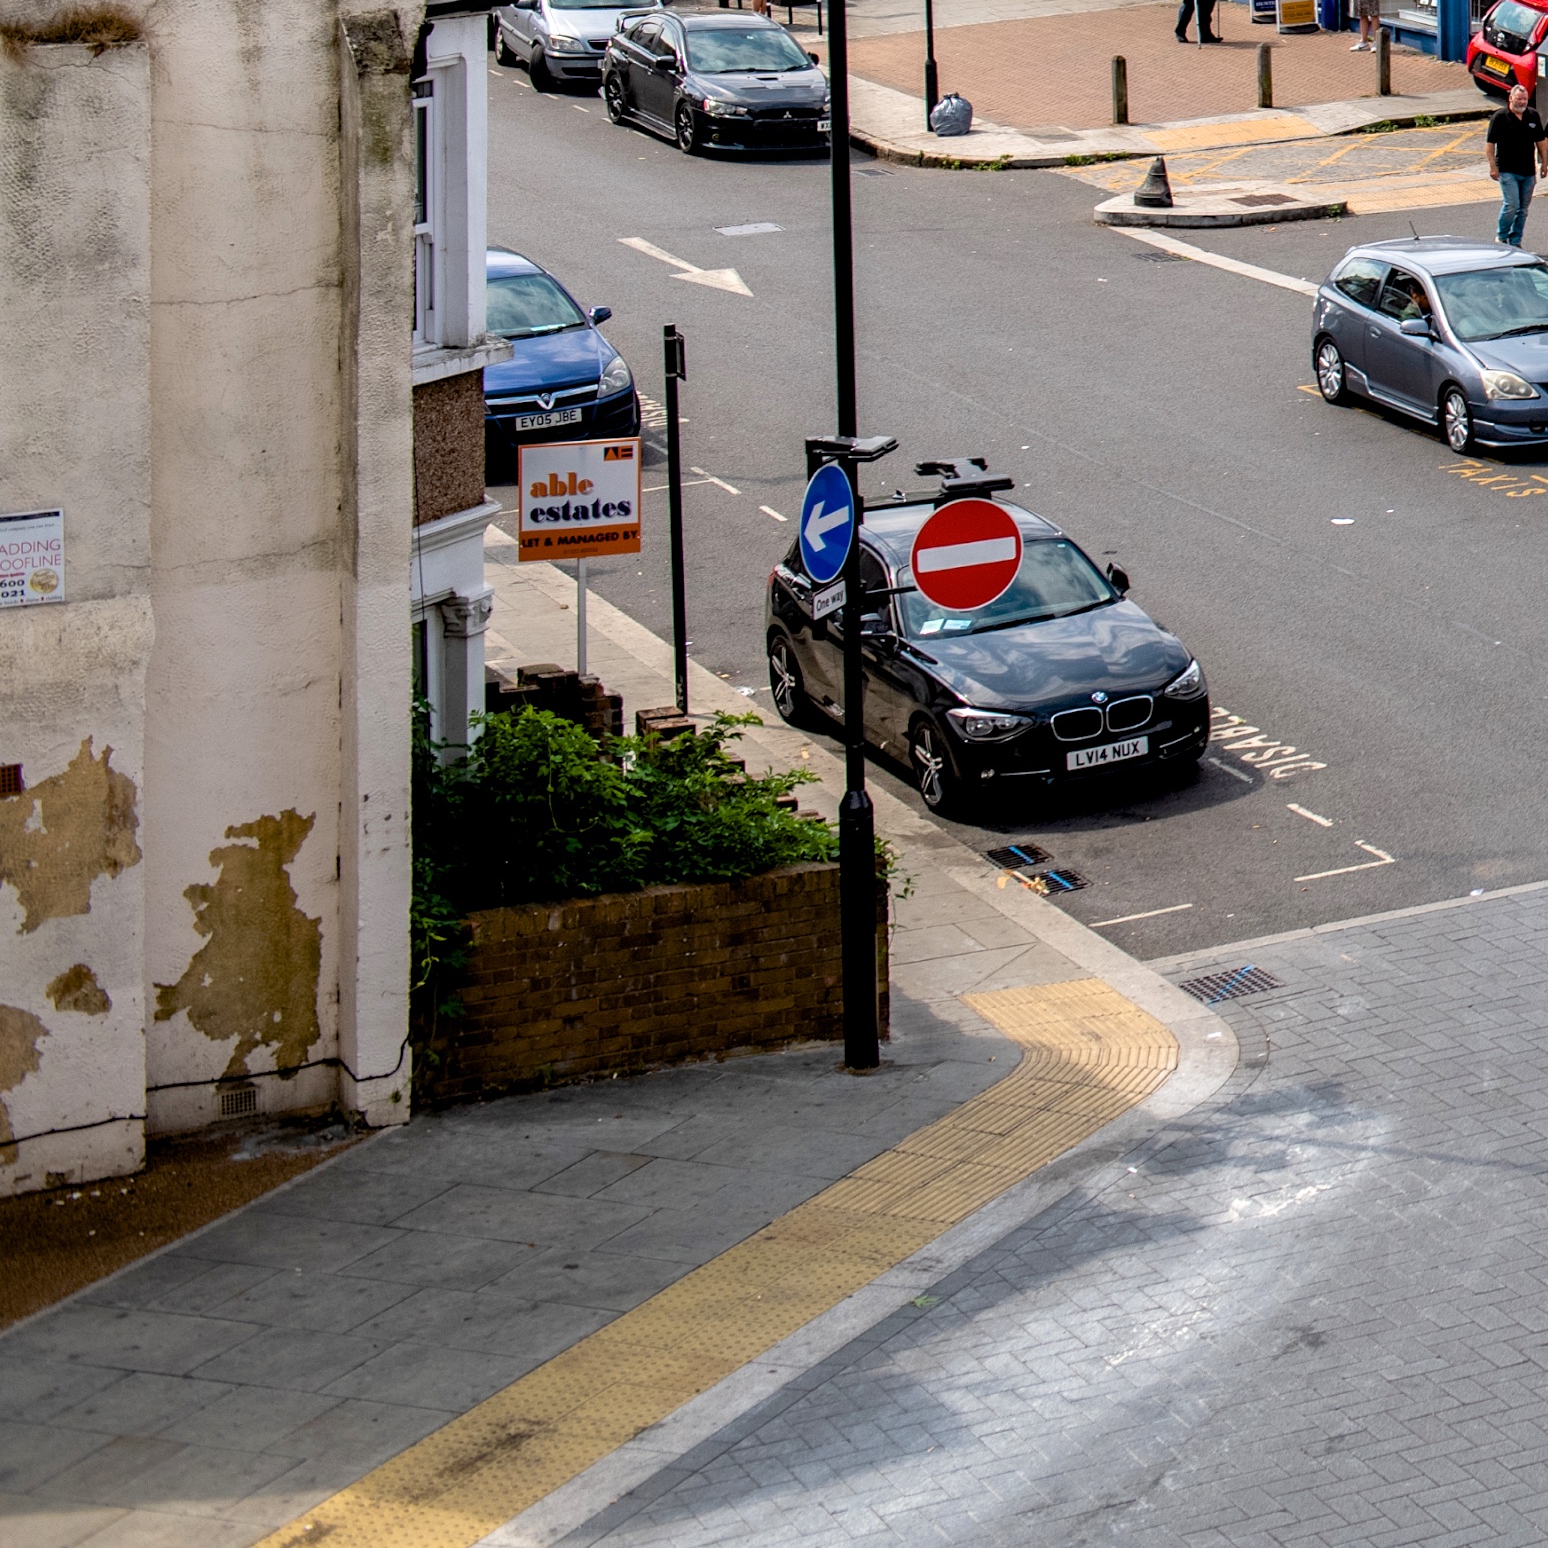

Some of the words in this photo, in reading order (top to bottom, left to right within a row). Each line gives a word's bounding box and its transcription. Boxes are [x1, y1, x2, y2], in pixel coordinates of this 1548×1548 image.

[520, 414, 552, 429] EY05
[555, 409, 578, 424] JBE
[529, 471, 594, 499] able
[1439, 459, 1547, 499] TAXIS
[529, 497, 632, 524] estates
[522, 538, 540, 548] LET
[544, 537, 553, 547] &
[557, 531, 619, 546] MANAGED
[816, 598, 830, 612] One
[831, 589, 844, 604] way
[1073, 747, 1111, 769] LV14
[1113, 739, 1141, 760] NUX
